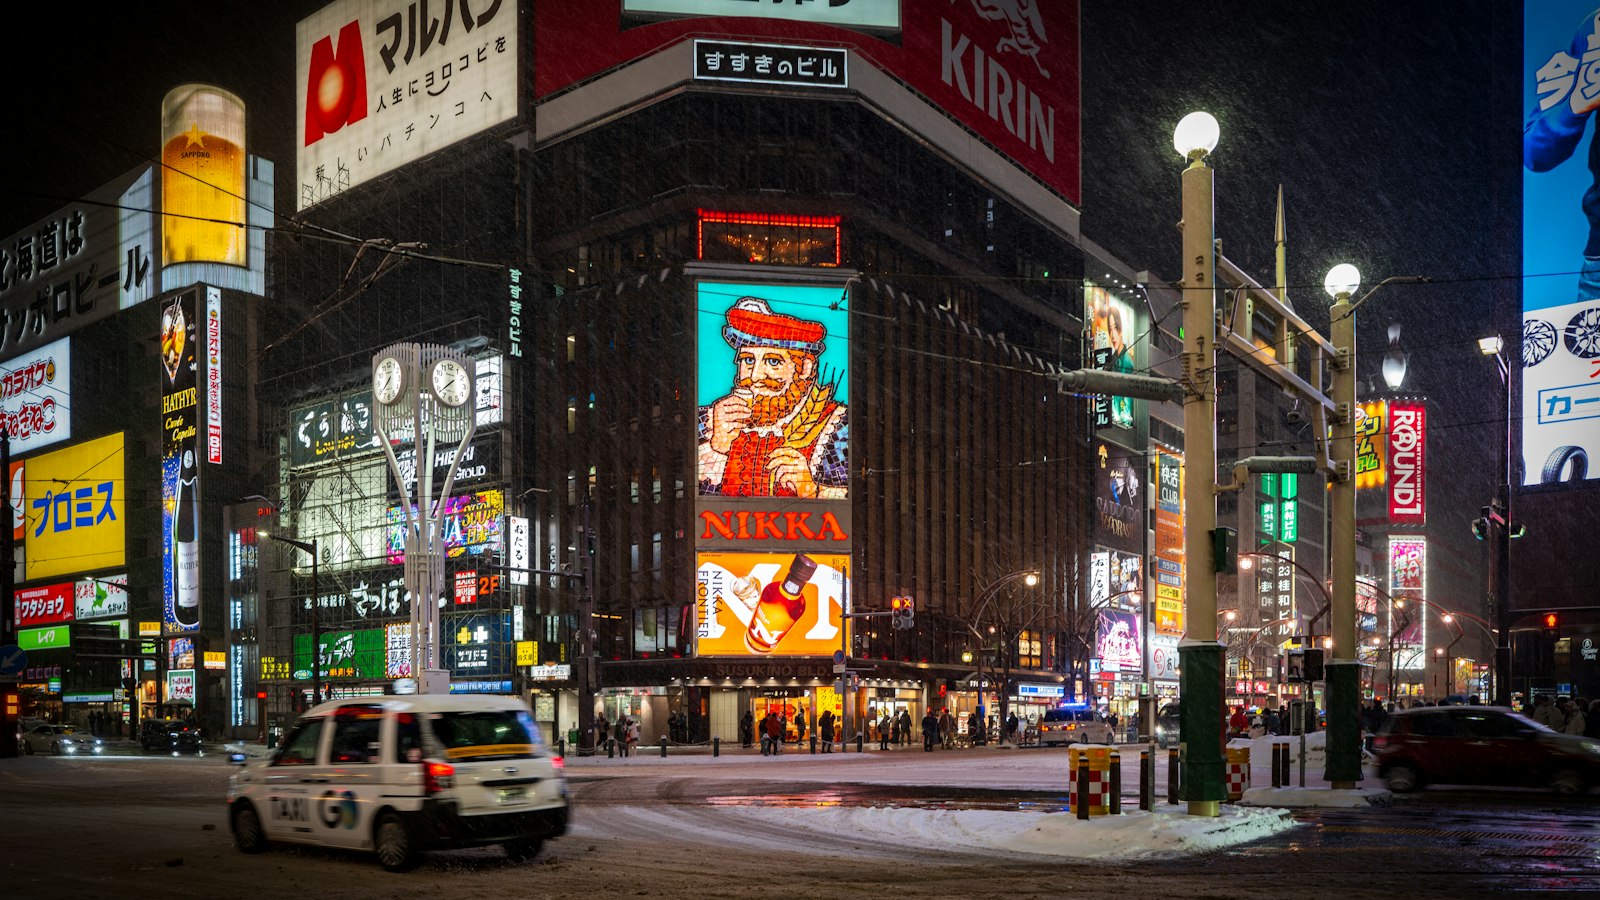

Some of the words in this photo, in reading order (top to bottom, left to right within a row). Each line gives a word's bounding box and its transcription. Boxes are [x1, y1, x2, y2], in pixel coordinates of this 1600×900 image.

[376, 36, 506, 112] 人生にヨロコビを
[705, 52, 837, 77] すすきのビル
[942, 17, 1054, 164] KIRIN
[180, 151, 210, 159] SAPPORO
[509, 268, 521, 357] すすきのビル
[2, 361, 47, 398] カラオケ
[163, 387, 196, 414] HATHYR
[1161, 465, 1178, 487] 快活
[33, 481, 117, 537] プロミス
[1161, 487, 1178, 505] CLUB
[700, 510, 849, 541] NIKKA
[479, 576, 500, 595] 2F
[712, 570, 723, 616] NIKKA
[21, 594, 64, 618] ワタショウ
[698, 570, 709, 638] FRONTIER
[38, 630, 55, 644] レイク
[717, 665, 793, 677] SUSUKINO
